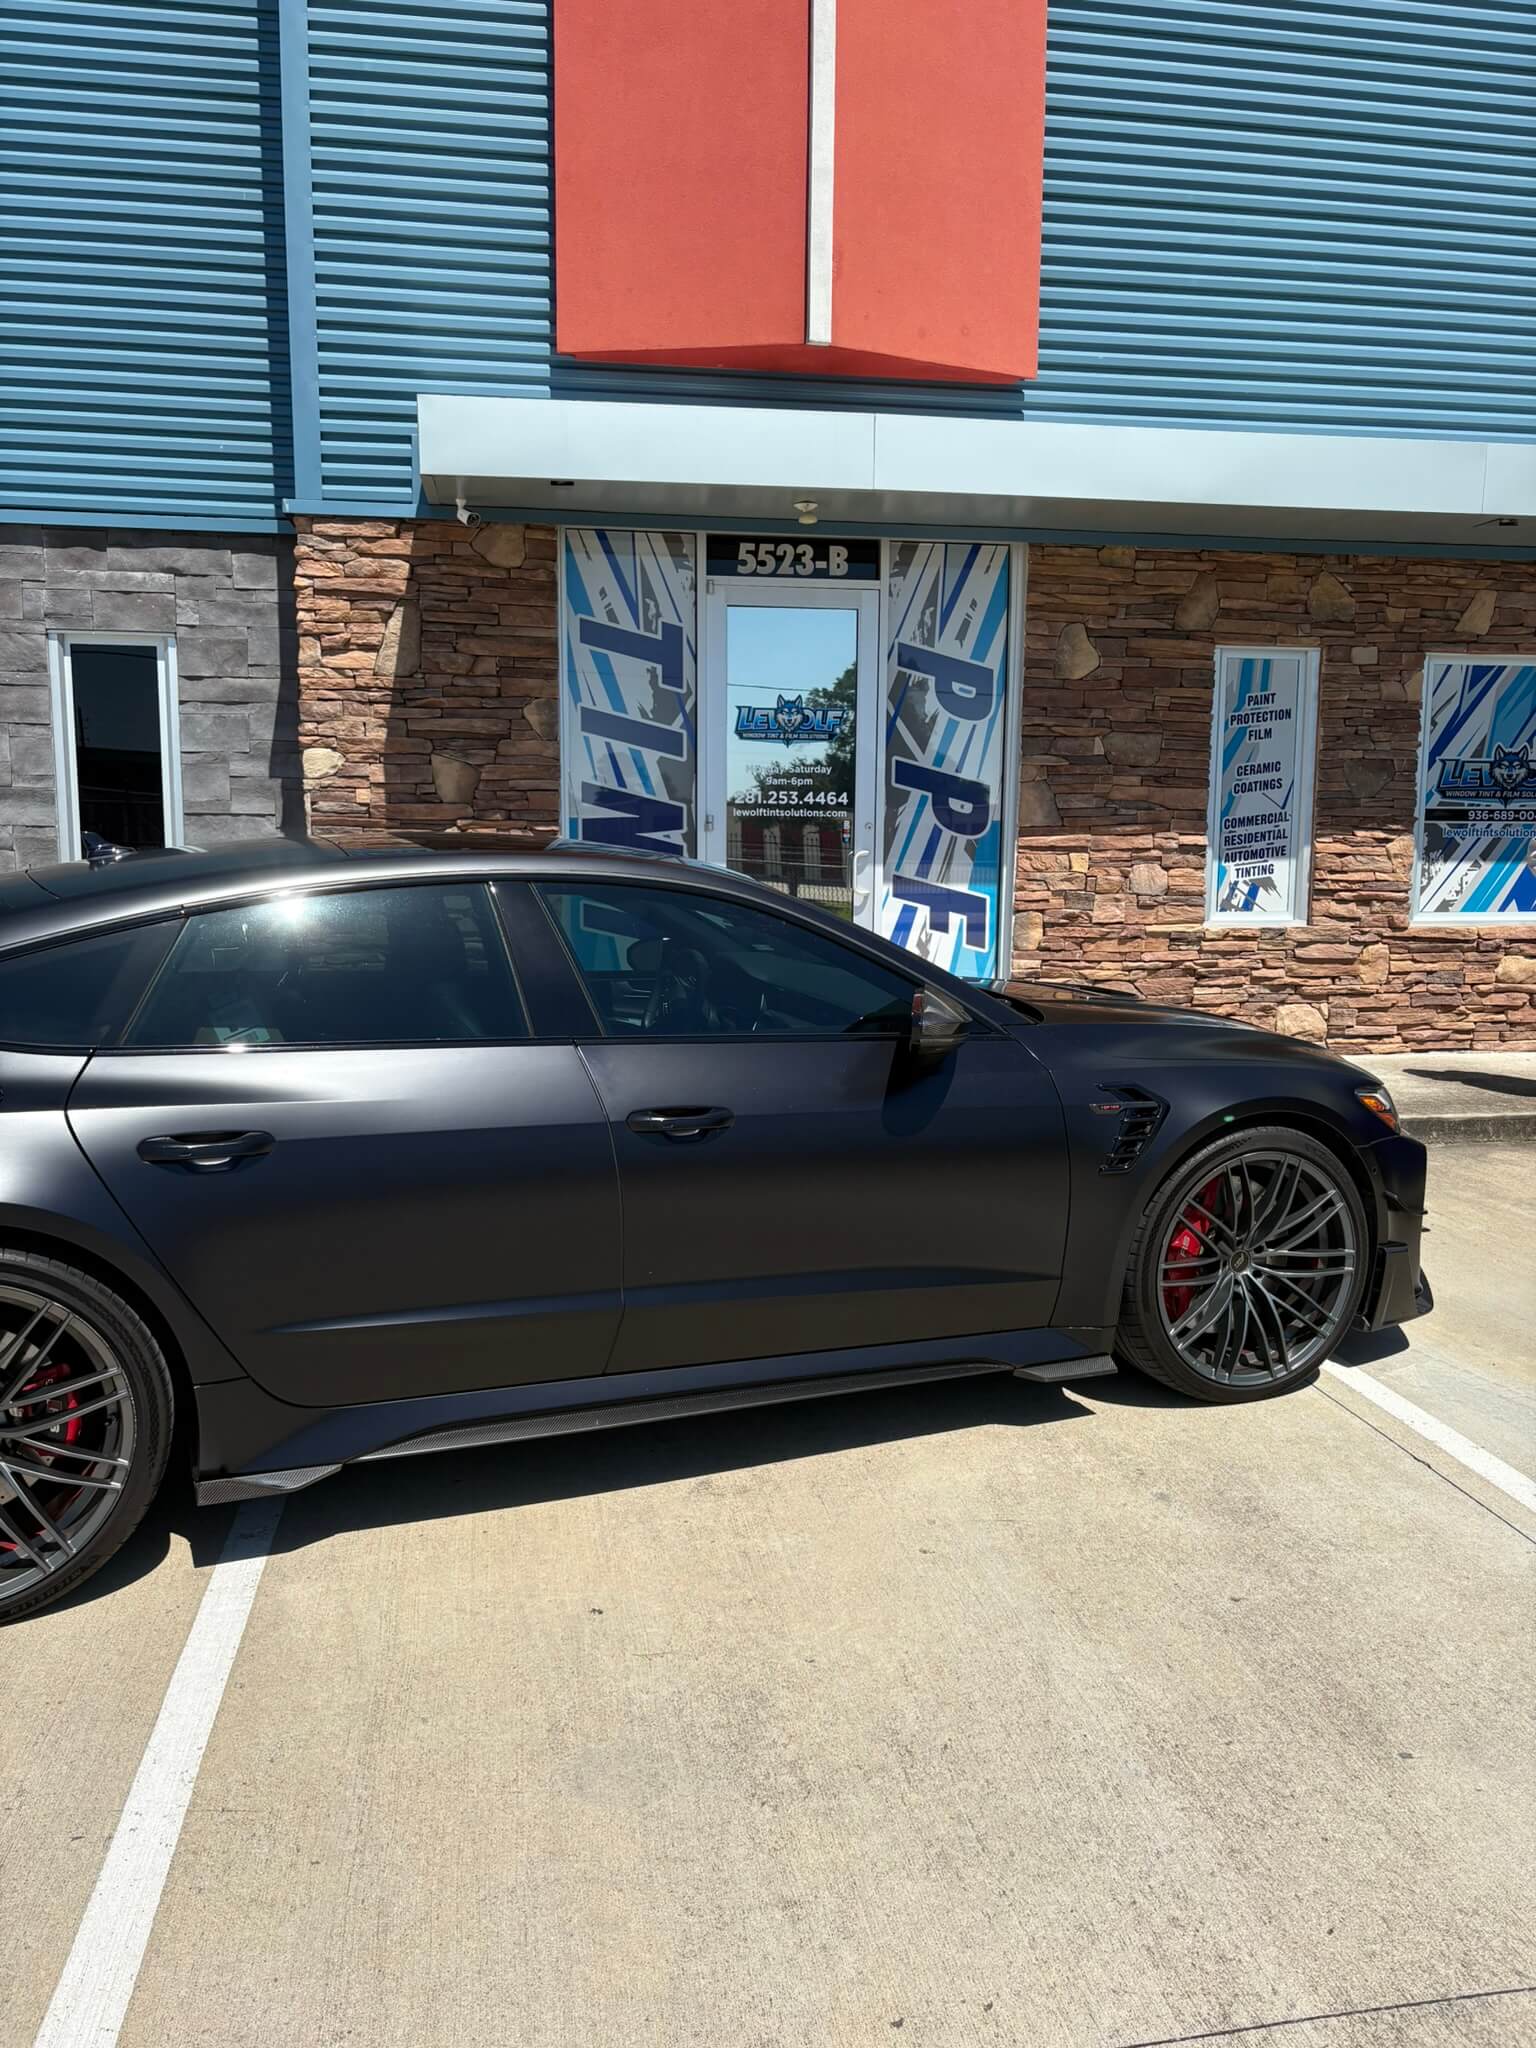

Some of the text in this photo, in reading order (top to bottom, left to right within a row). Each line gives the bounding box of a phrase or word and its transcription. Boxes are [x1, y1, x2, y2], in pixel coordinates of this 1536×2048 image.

[737, 542, 849, 576] 5523-B
[1247, 693, 1276, 707] PAINT
[1230, 708, 1292, 726] PROTECTION
[1248, 728, 1272, 741] FILM
[1237, 761, 1281, 777] CERAMIC
[766, 777, 813, 787] 9am-6pm
[1234, 779, 1283, 795] COATINGS
[734, 791, 849, 805] 281.253.4464
[893, 642, 994, 950] PPF
[733, 808, 847, 818] lewolftintsolutions.com
[1224, 811, 1289, 830] COMMERCIAL
[1468, 811, 1536, 820] 936-689-00
[1224, 829, 1288, 847] RESIDENTIAL
[1224, 845, 1287, 863] AUTOMOTIVE
[1235, 864, 1274, 879] TINTING
